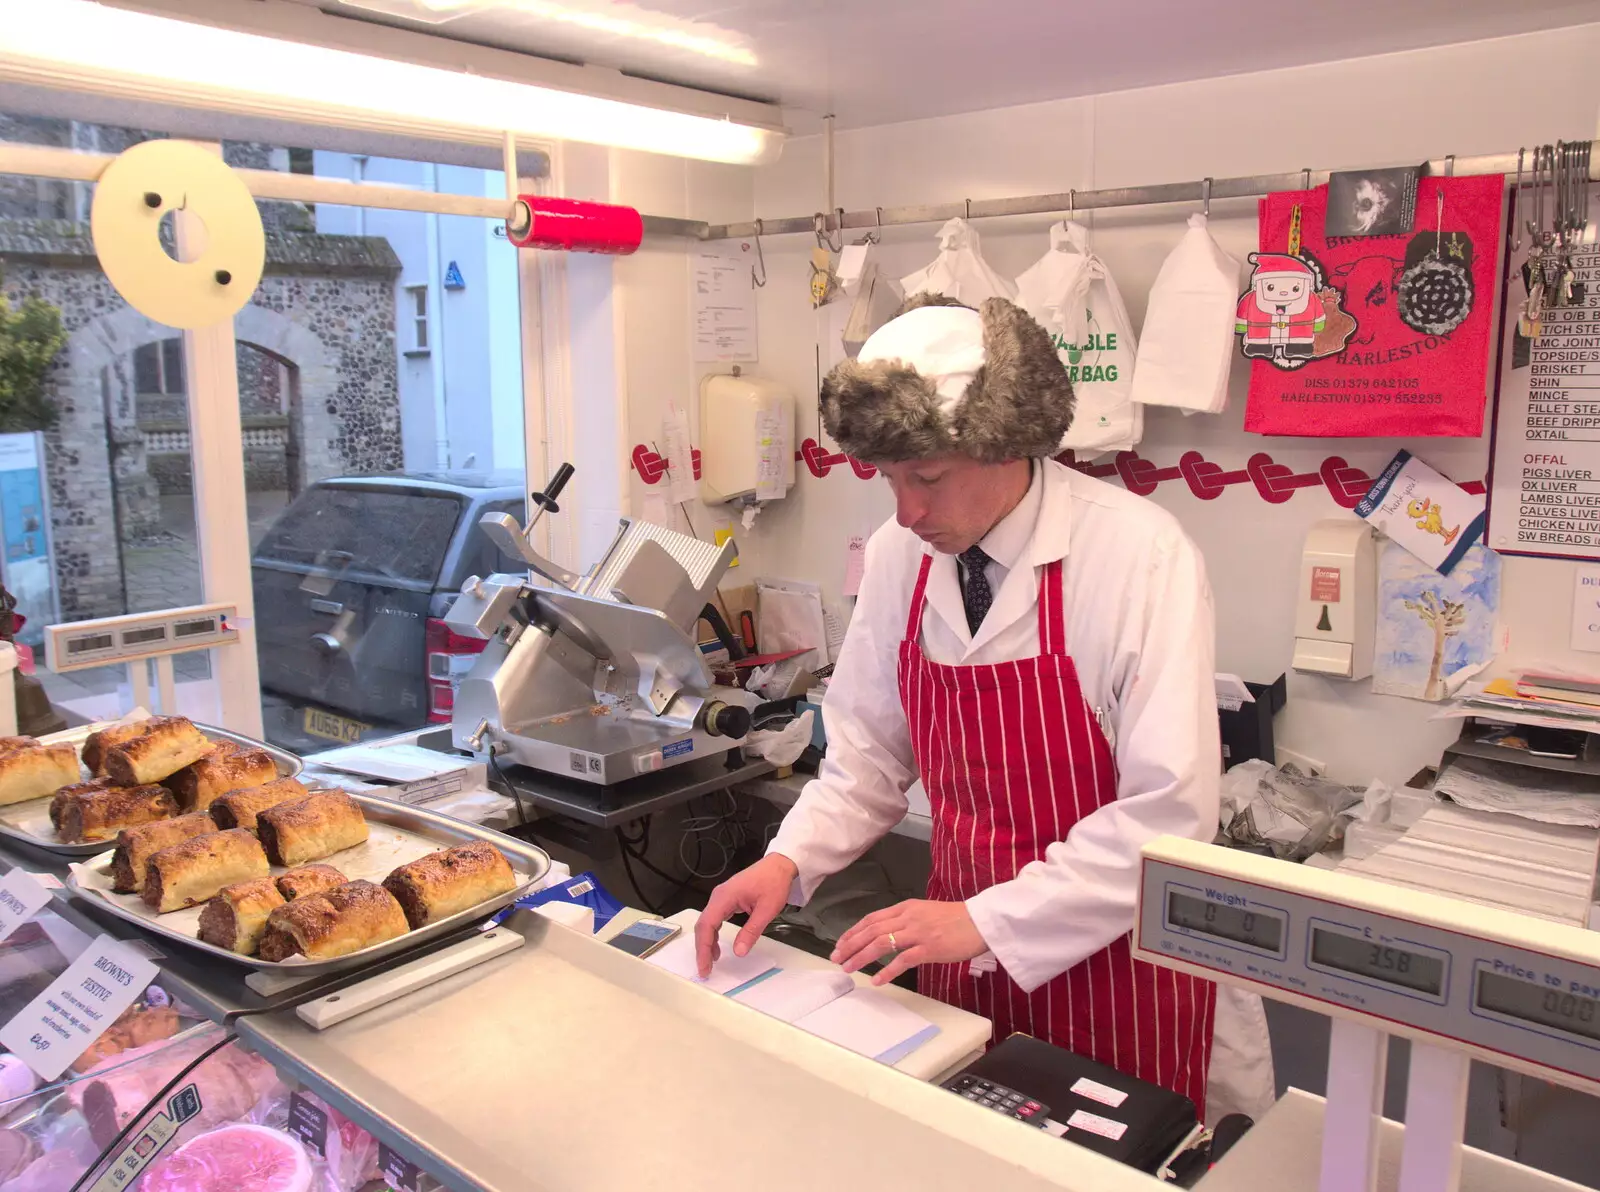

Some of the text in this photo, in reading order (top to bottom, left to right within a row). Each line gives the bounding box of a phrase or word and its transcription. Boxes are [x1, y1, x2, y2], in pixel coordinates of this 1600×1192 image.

[1563, 311, 1585, 321] O/B
[1533, 337, 1560, 348] LMC
[1336, 332, 1453, 366] HARLESTON
[1081, 364, 1118, 382] BAG
[1530, 364, 1586, 374] BRISKET
[1304, 378, 1330, 388] DISS
[1333, 378, 1369, 389] 01379
[1529, 377, 1560, 387] SHIN
[1280, 393, 1352, 403] HARLESTON
[1354, 394, 1392, 404] 01379
[1529, 390, 1569, 400] MINCE
[1527, 403, 1570, 414] FILLET
[1527, 416, 1559, 426] BEEF
[1525, 429, 1569, 440] OXTAIL
[1523, 454, 1568, 465] OFFAL
[1522, 467, 1592, 480] PIGS LIVER
[1521, 480, 1577, 492] OX LIVER
[1380, 493, 1405, 516] Thank
[1520, 493, 1563, 504] LAMBS
[1519, 506, 1600, 519] CALVES LIVE
[1518, 518, 1600, 532] CHICKEN LIV
[1517, 531, 1537, 541] SW
[1539, 533, 1591, 545] BREADS
[1205, 887, 1248, 907] Weight
[93, 956, 134, 986] BROWNE'S
[1494, 958, 1536, 980] Price
[1544, 973, 1562, 987] to
[80, 977, 113, 1001] FESTIVE
[123, 1154, 140, 1171] VISA
[113, 1168, 126, 1182] VISA
